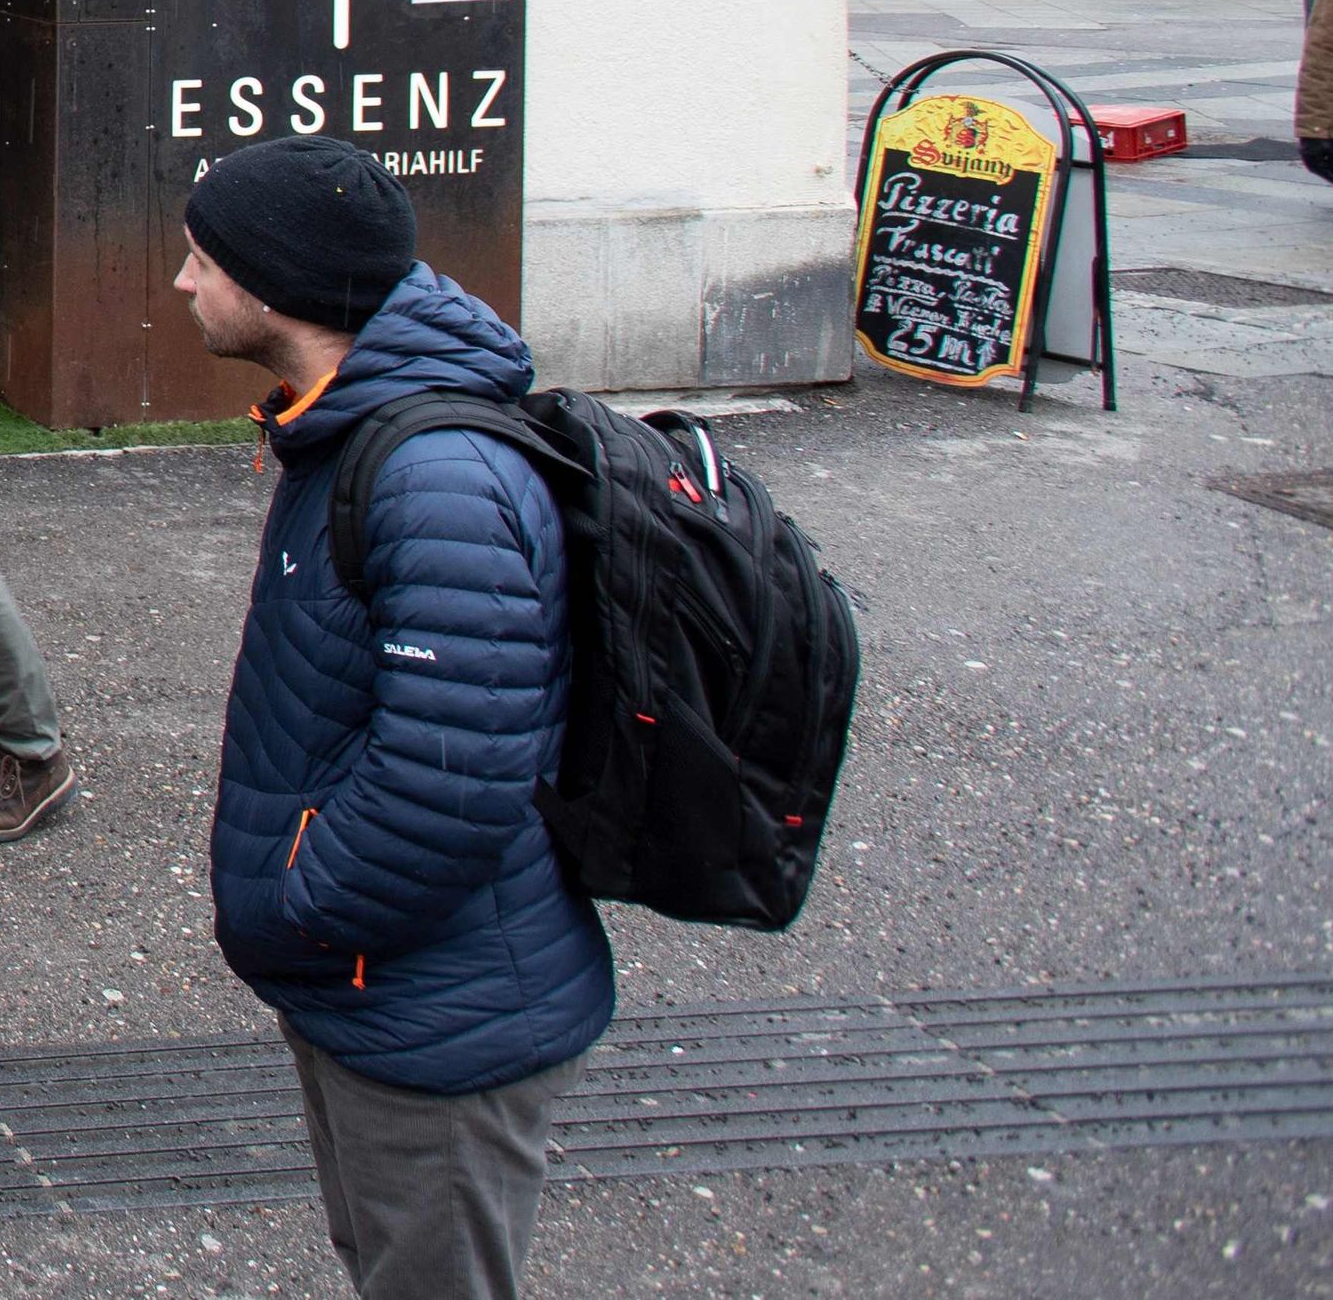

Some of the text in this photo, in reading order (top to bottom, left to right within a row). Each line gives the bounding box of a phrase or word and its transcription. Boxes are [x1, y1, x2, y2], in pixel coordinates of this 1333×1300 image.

[172, 71, 506, 137] ESSENZ
[910, 139, 1013, 180] Svijany
[877, 171, 1019, 233] Pizzeria
[383, 643, 437, 661] SALEWA
